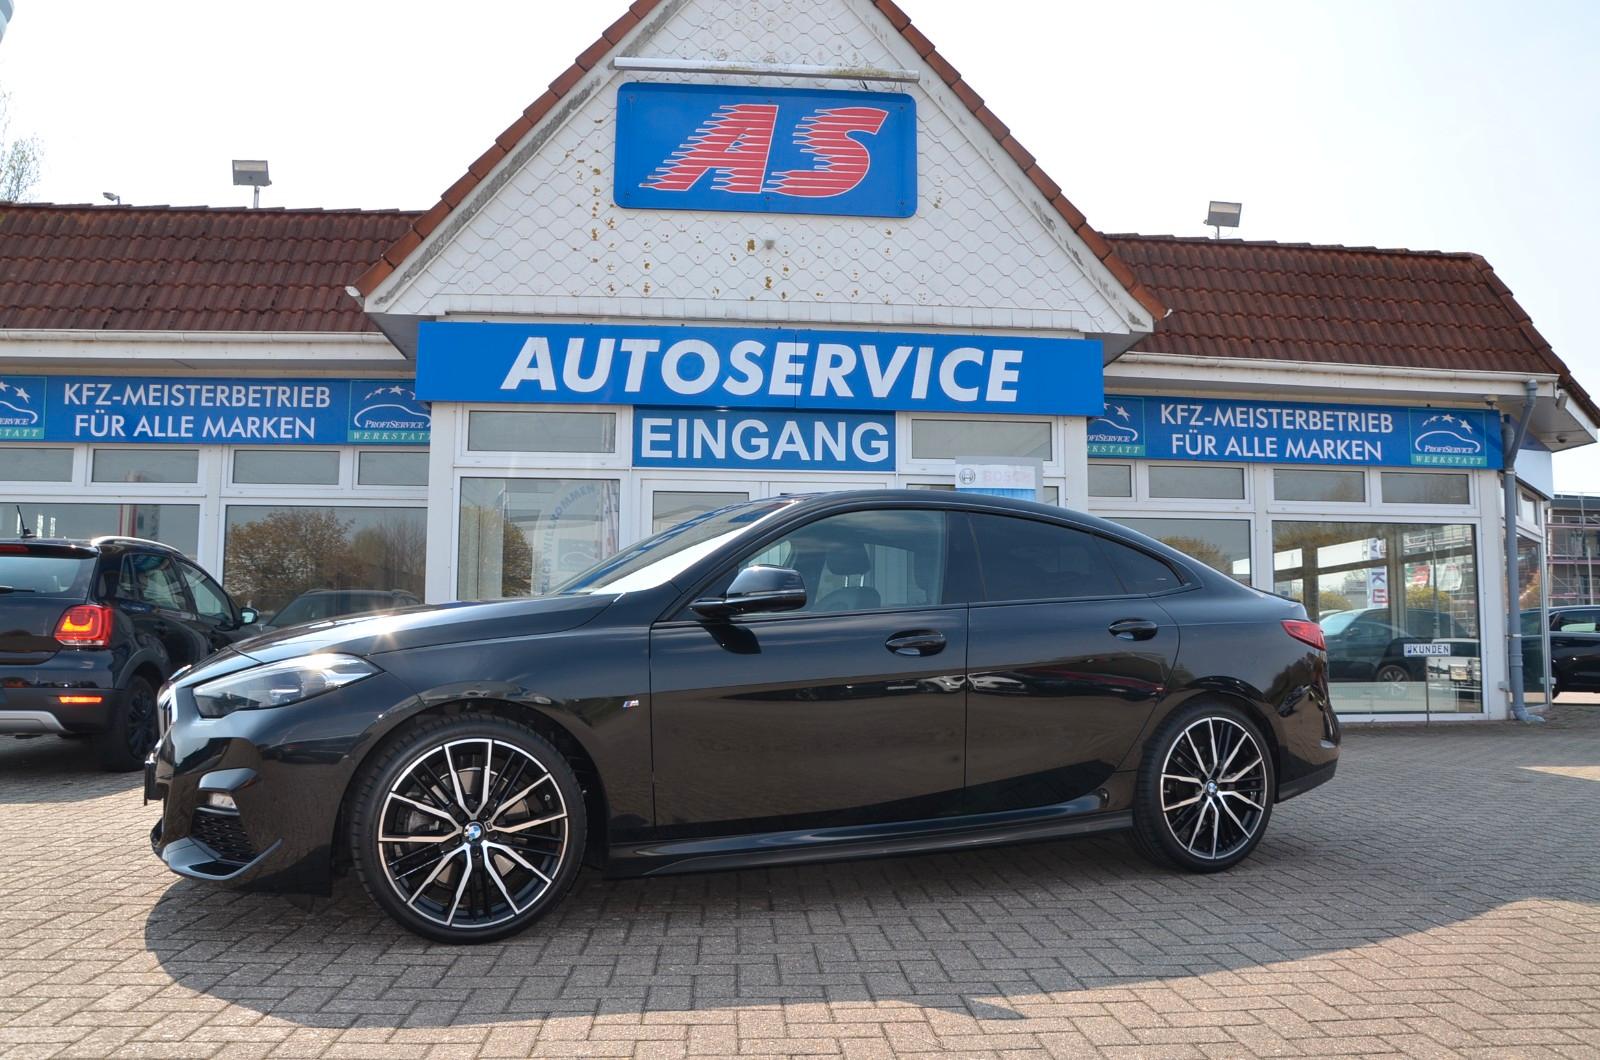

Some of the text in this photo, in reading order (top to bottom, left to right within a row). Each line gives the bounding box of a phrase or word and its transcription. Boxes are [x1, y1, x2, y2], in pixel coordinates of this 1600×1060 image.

[639, 103, 889, 198] AS
[501, 336, 1024, 403] AUTOSERVICE
[64, 383, 331, 409] KFZ-MEISTERBETRIEB
[75, 410, 316, 440] FÜR ALLE MARKEN
[1160, 403, 1394, 434] KFZ-MEISTERBETRIEB
[640, 417, 889, 464] EINGANG
[1171, 430, 1382, 461] FÜR ALLE MARKEN
[1416, 455, 1483, 465] WERKSTATT
[1412, 645, 1449, 654] KUNDEN
